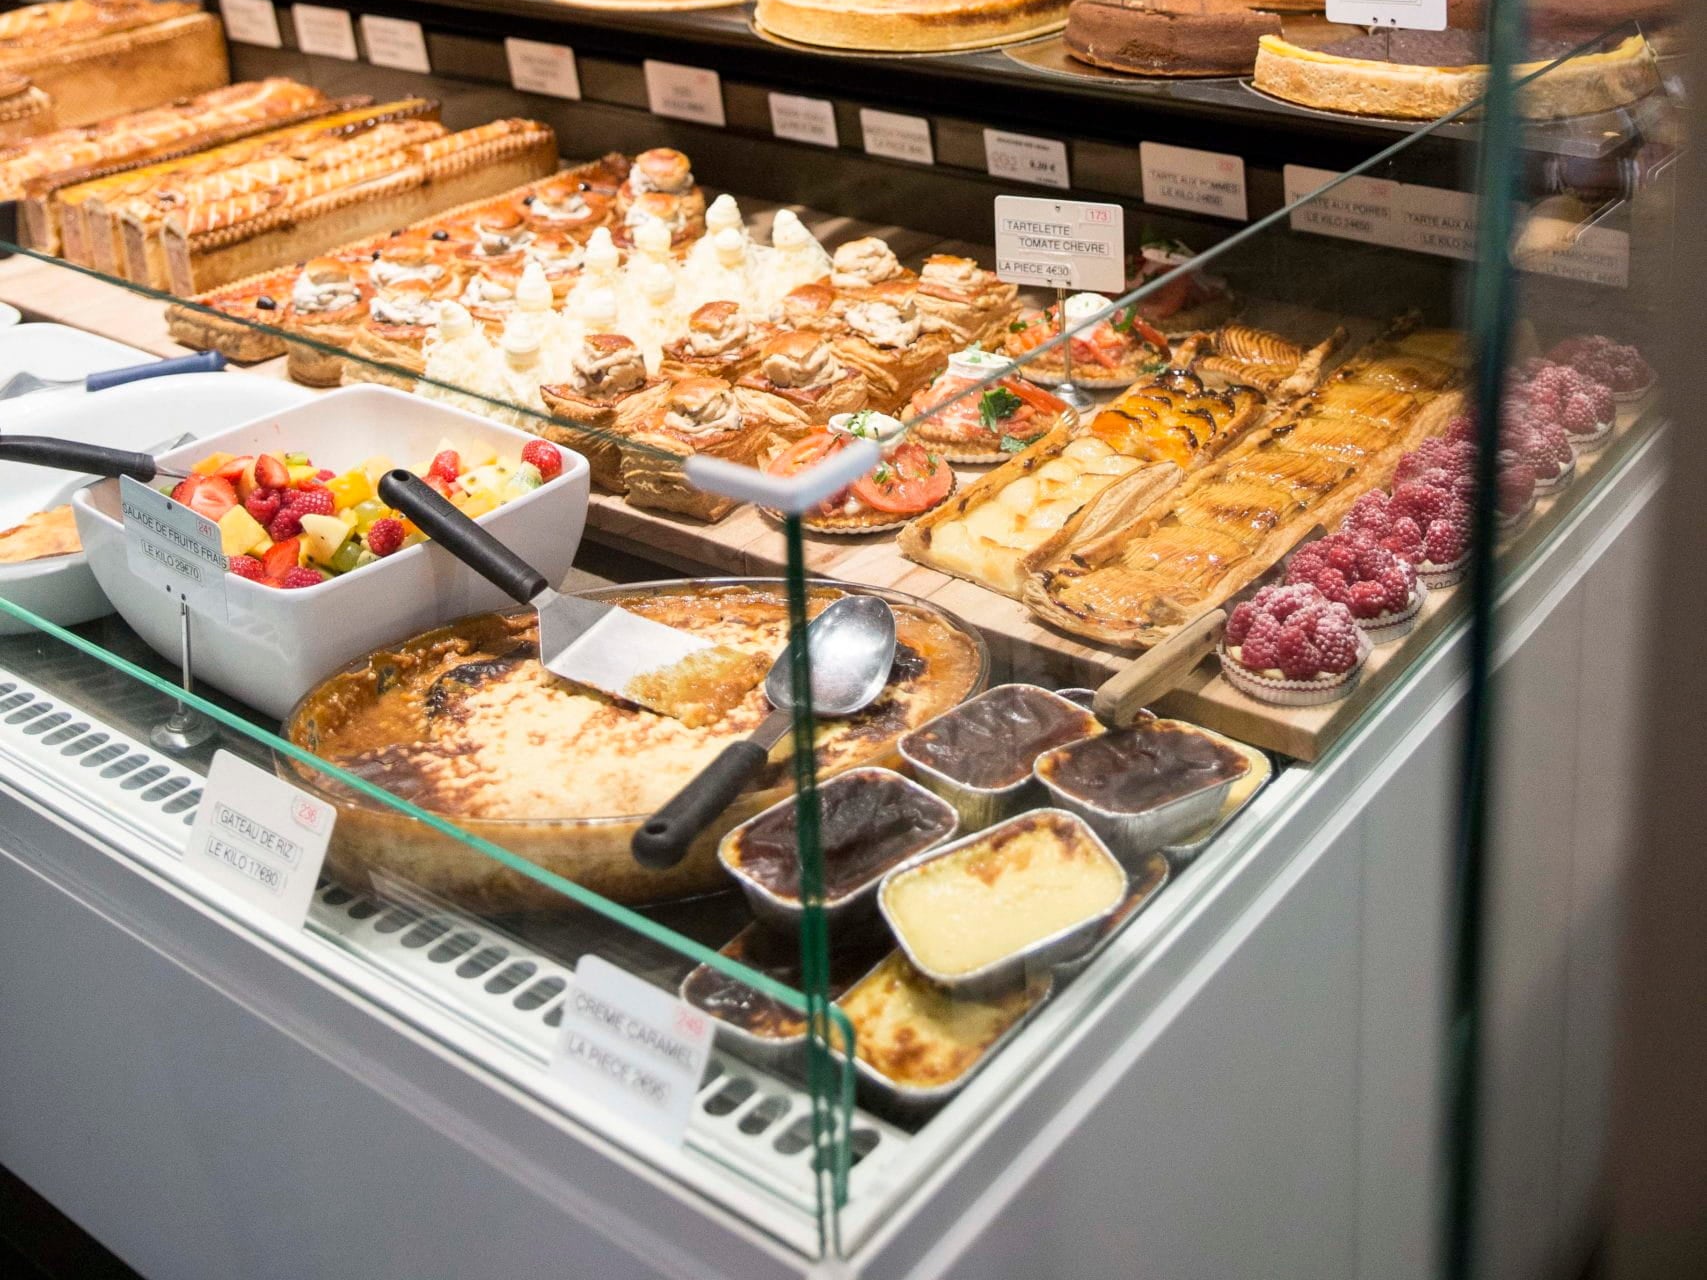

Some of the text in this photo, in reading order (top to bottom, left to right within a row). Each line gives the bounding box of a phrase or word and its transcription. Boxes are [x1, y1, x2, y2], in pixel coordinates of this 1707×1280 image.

[1161, 185, 1173, 197] LE
[1175, 189, 1194, 200] KILO
[1090, 209, 1108, 221] 173
[1332, 201, 1351, 212] AUX
[1352, 203, 1388, 218] POIRES
[1305, 211, 1319, 223] LE
[1321, 216, 1342, 226] KILO
[1408, 212, 1437, 226] TARTE
[1441, 219, 1460, 229] AUX
[1007, 221, 1071, 236] TARTELETTE
[1019, 237, 1105, 254] TOMATE CHEVRE
[1424, 234, 1436, 244] LE
[1439, 238, 1460, 249] KILO
[998, 262, 1069, 276] LA PIECE 4€30
[122, 503, 227, 570] SALADE DE FRUITS FRAIS
[198, 523, 212, 537] 241
[143, 542, 154, 555] LE
[154, 547, 174, 567] KILO
[220, 809, 294, 859] GATEAU DE RIZ
[207, 839, 223, 857] LE
[223, 847, 248, 870] KILO
[575, 991, 693, 1066] CREME CARAMEL
[567, 1030, 585, 1057] LA
[588, 1046, 632, 1080] PIECE
